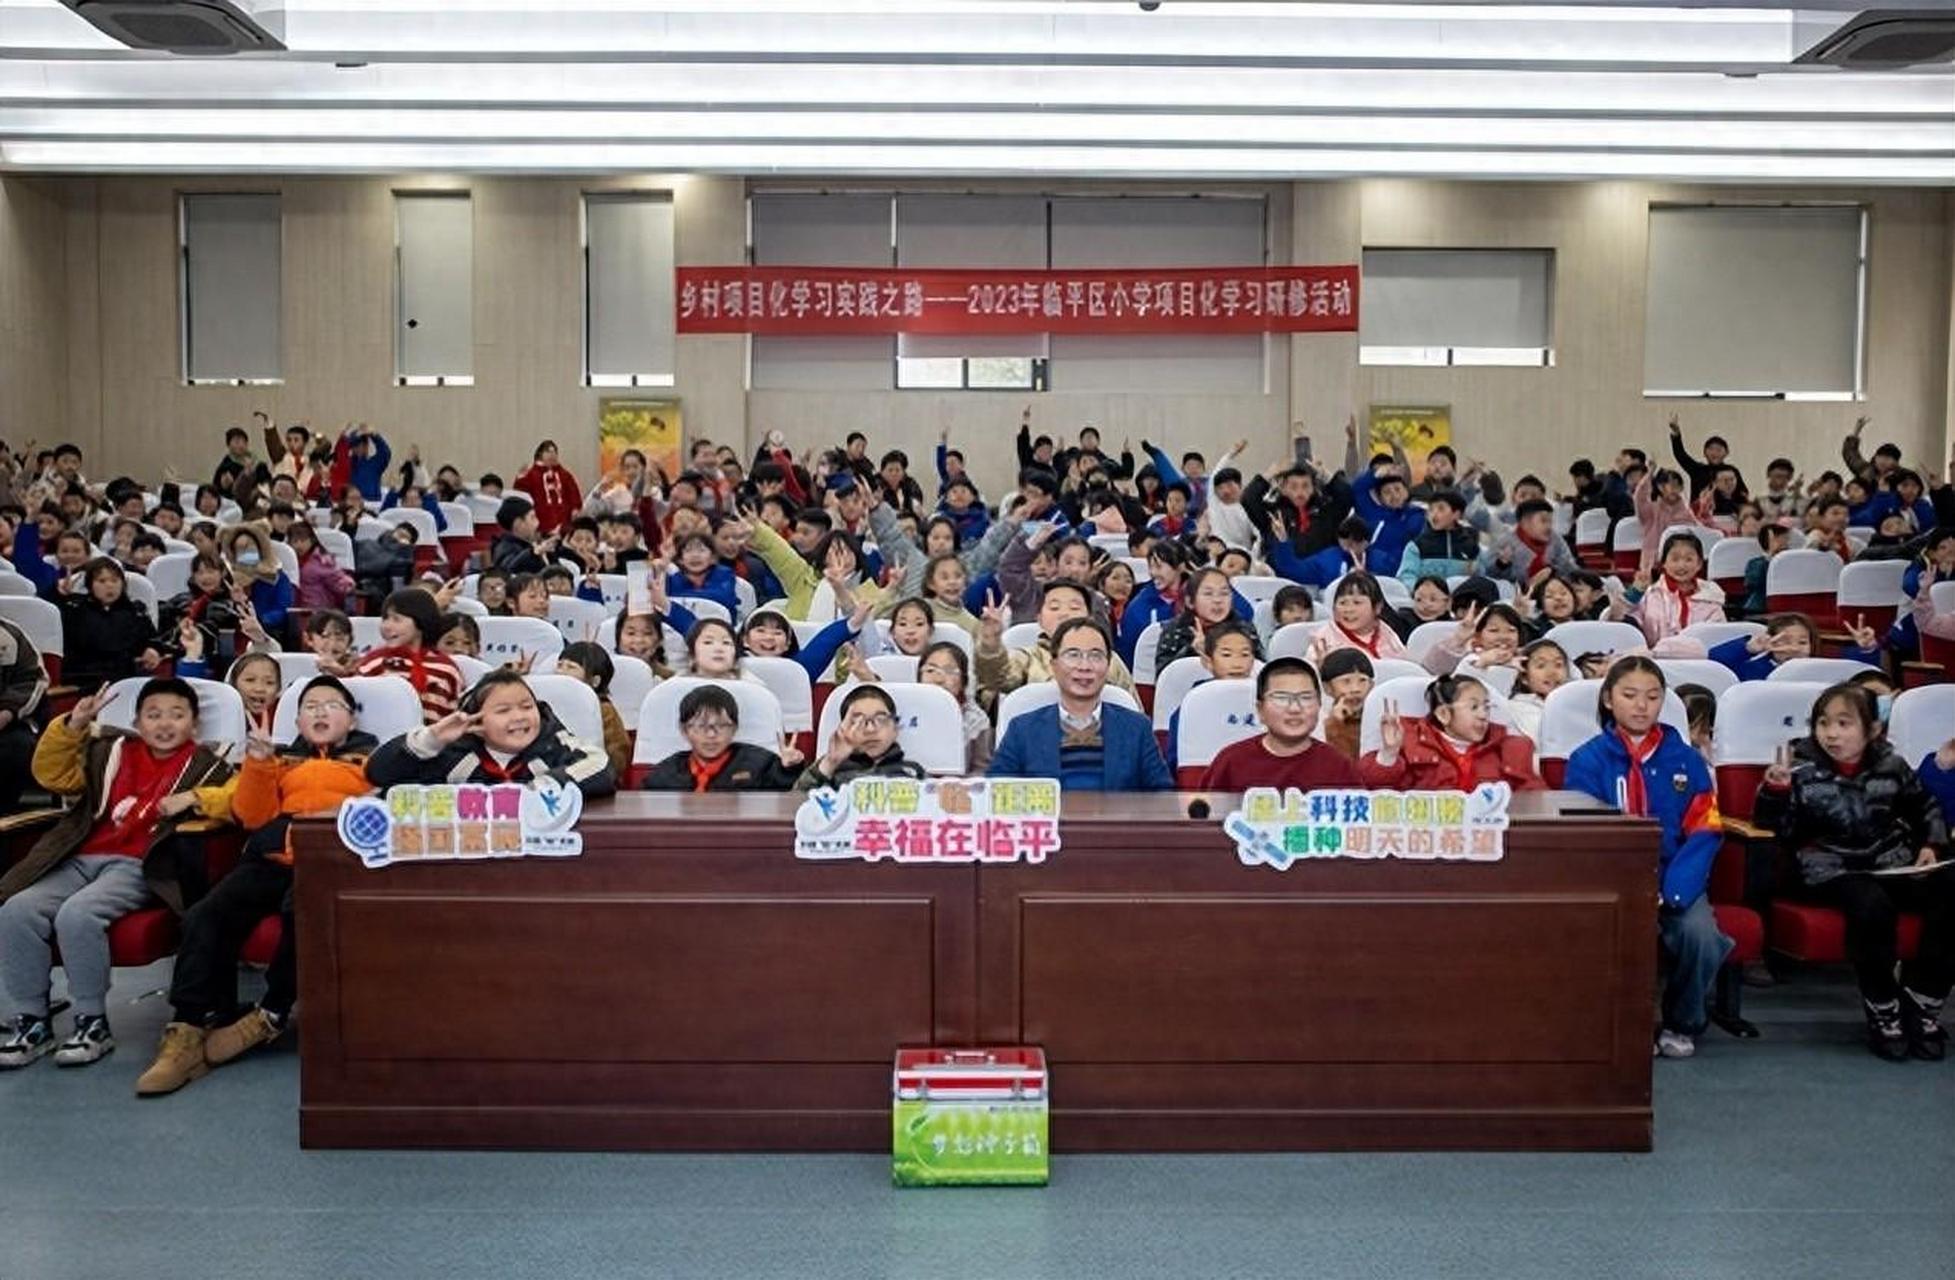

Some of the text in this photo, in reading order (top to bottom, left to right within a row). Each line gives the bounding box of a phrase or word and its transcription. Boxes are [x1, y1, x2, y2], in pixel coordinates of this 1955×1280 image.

[855, 819, 1056, 857] 幸福在临平
